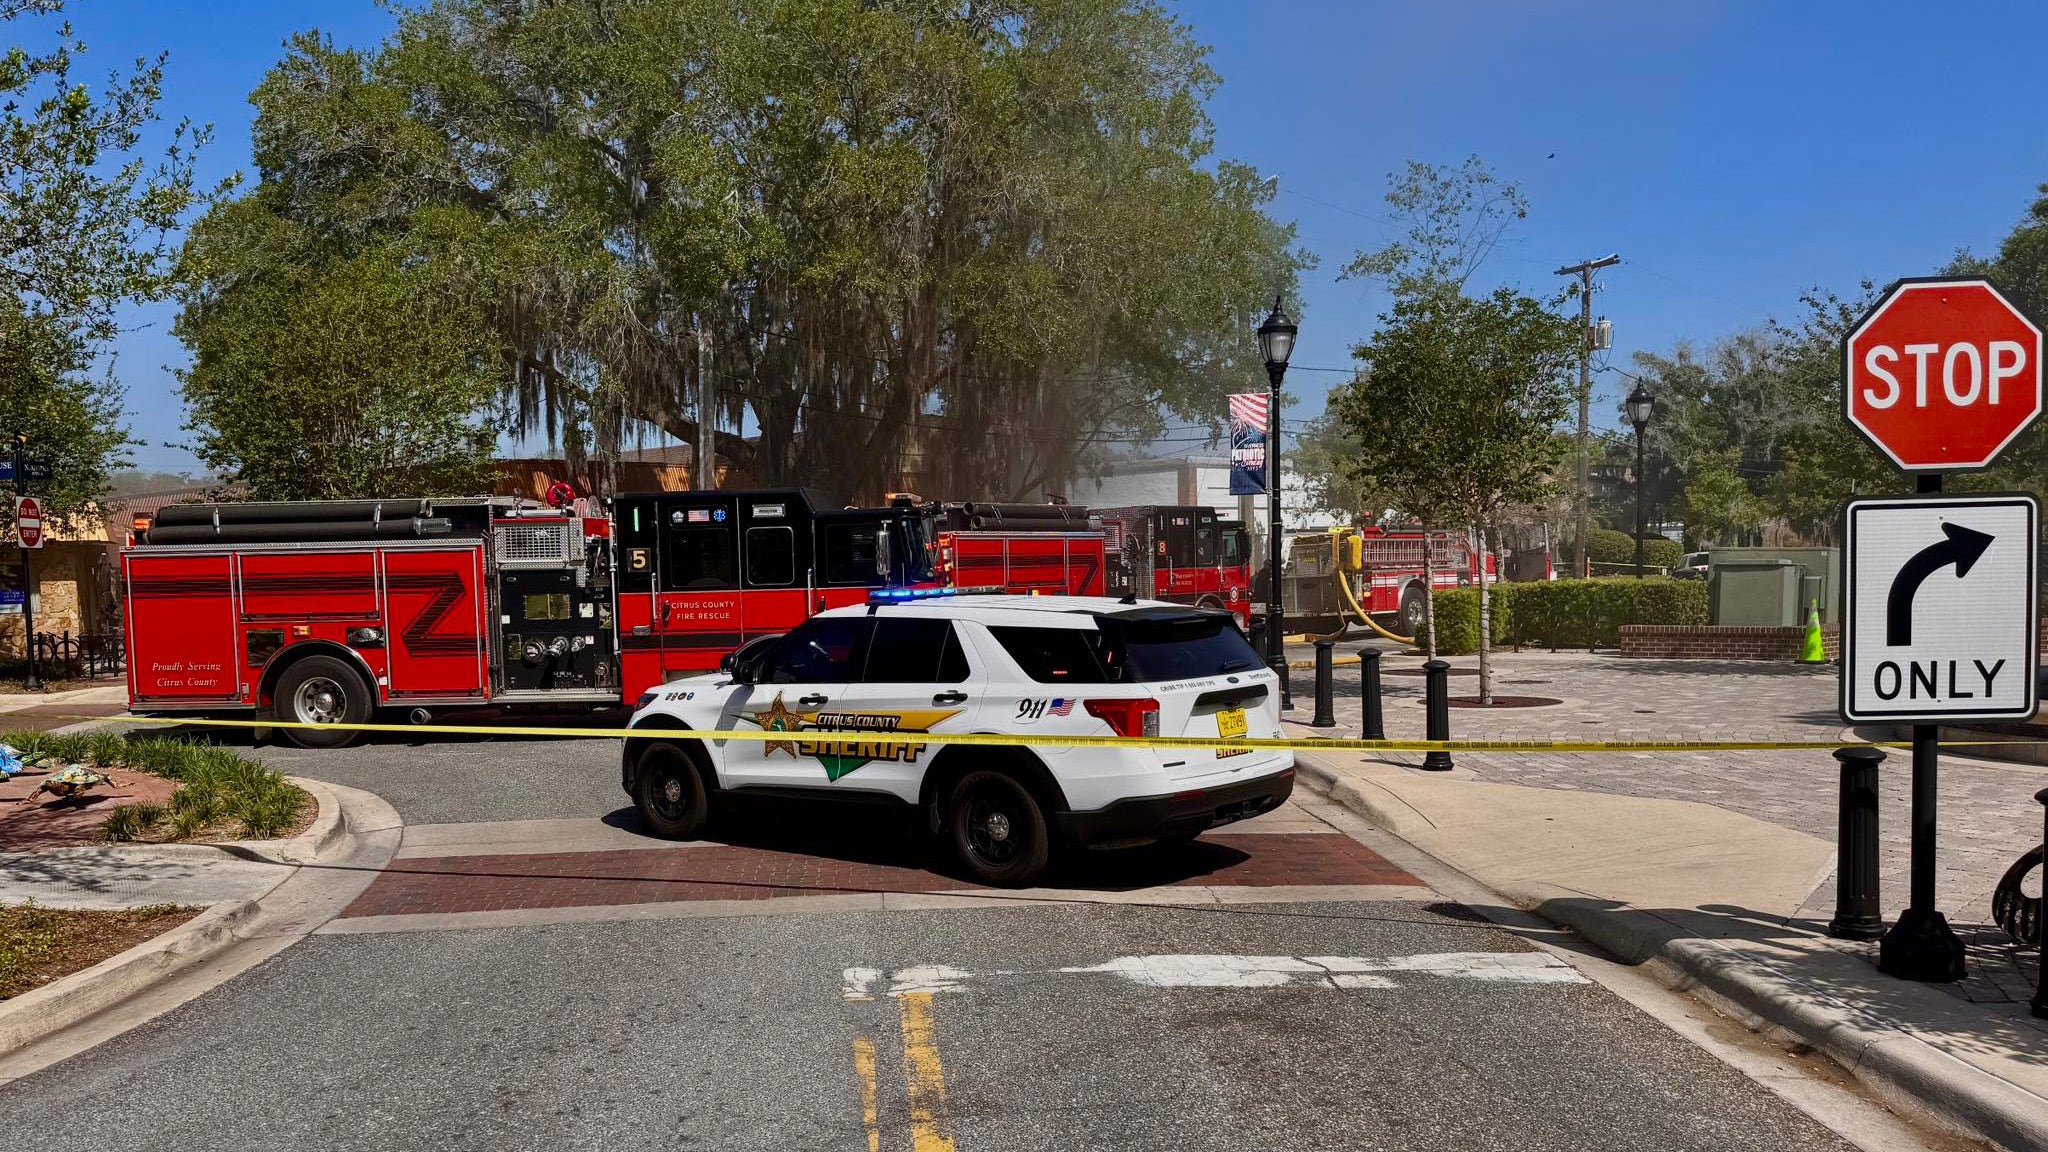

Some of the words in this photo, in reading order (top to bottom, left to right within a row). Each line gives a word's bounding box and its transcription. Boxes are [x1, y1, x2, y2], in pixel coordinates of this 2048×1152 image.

[1863, 341, 2026, 409] STOP
[632, 550, 646, 569] 5
[698, 612, 730, 620] RESCUE
[152, 662, 183, 672] Proudly
[187, 661, 221, 672] Serving
[157, 677, 184, 687] Citrus
[187, 677, 218, 688] County
[1874, 659, 2006, 700] ONLY
[817, 714, 854, 726] CITRUS
[857, 715, 900, 727] COUNTY
[800, 728, 926, 760] SHERIFF
